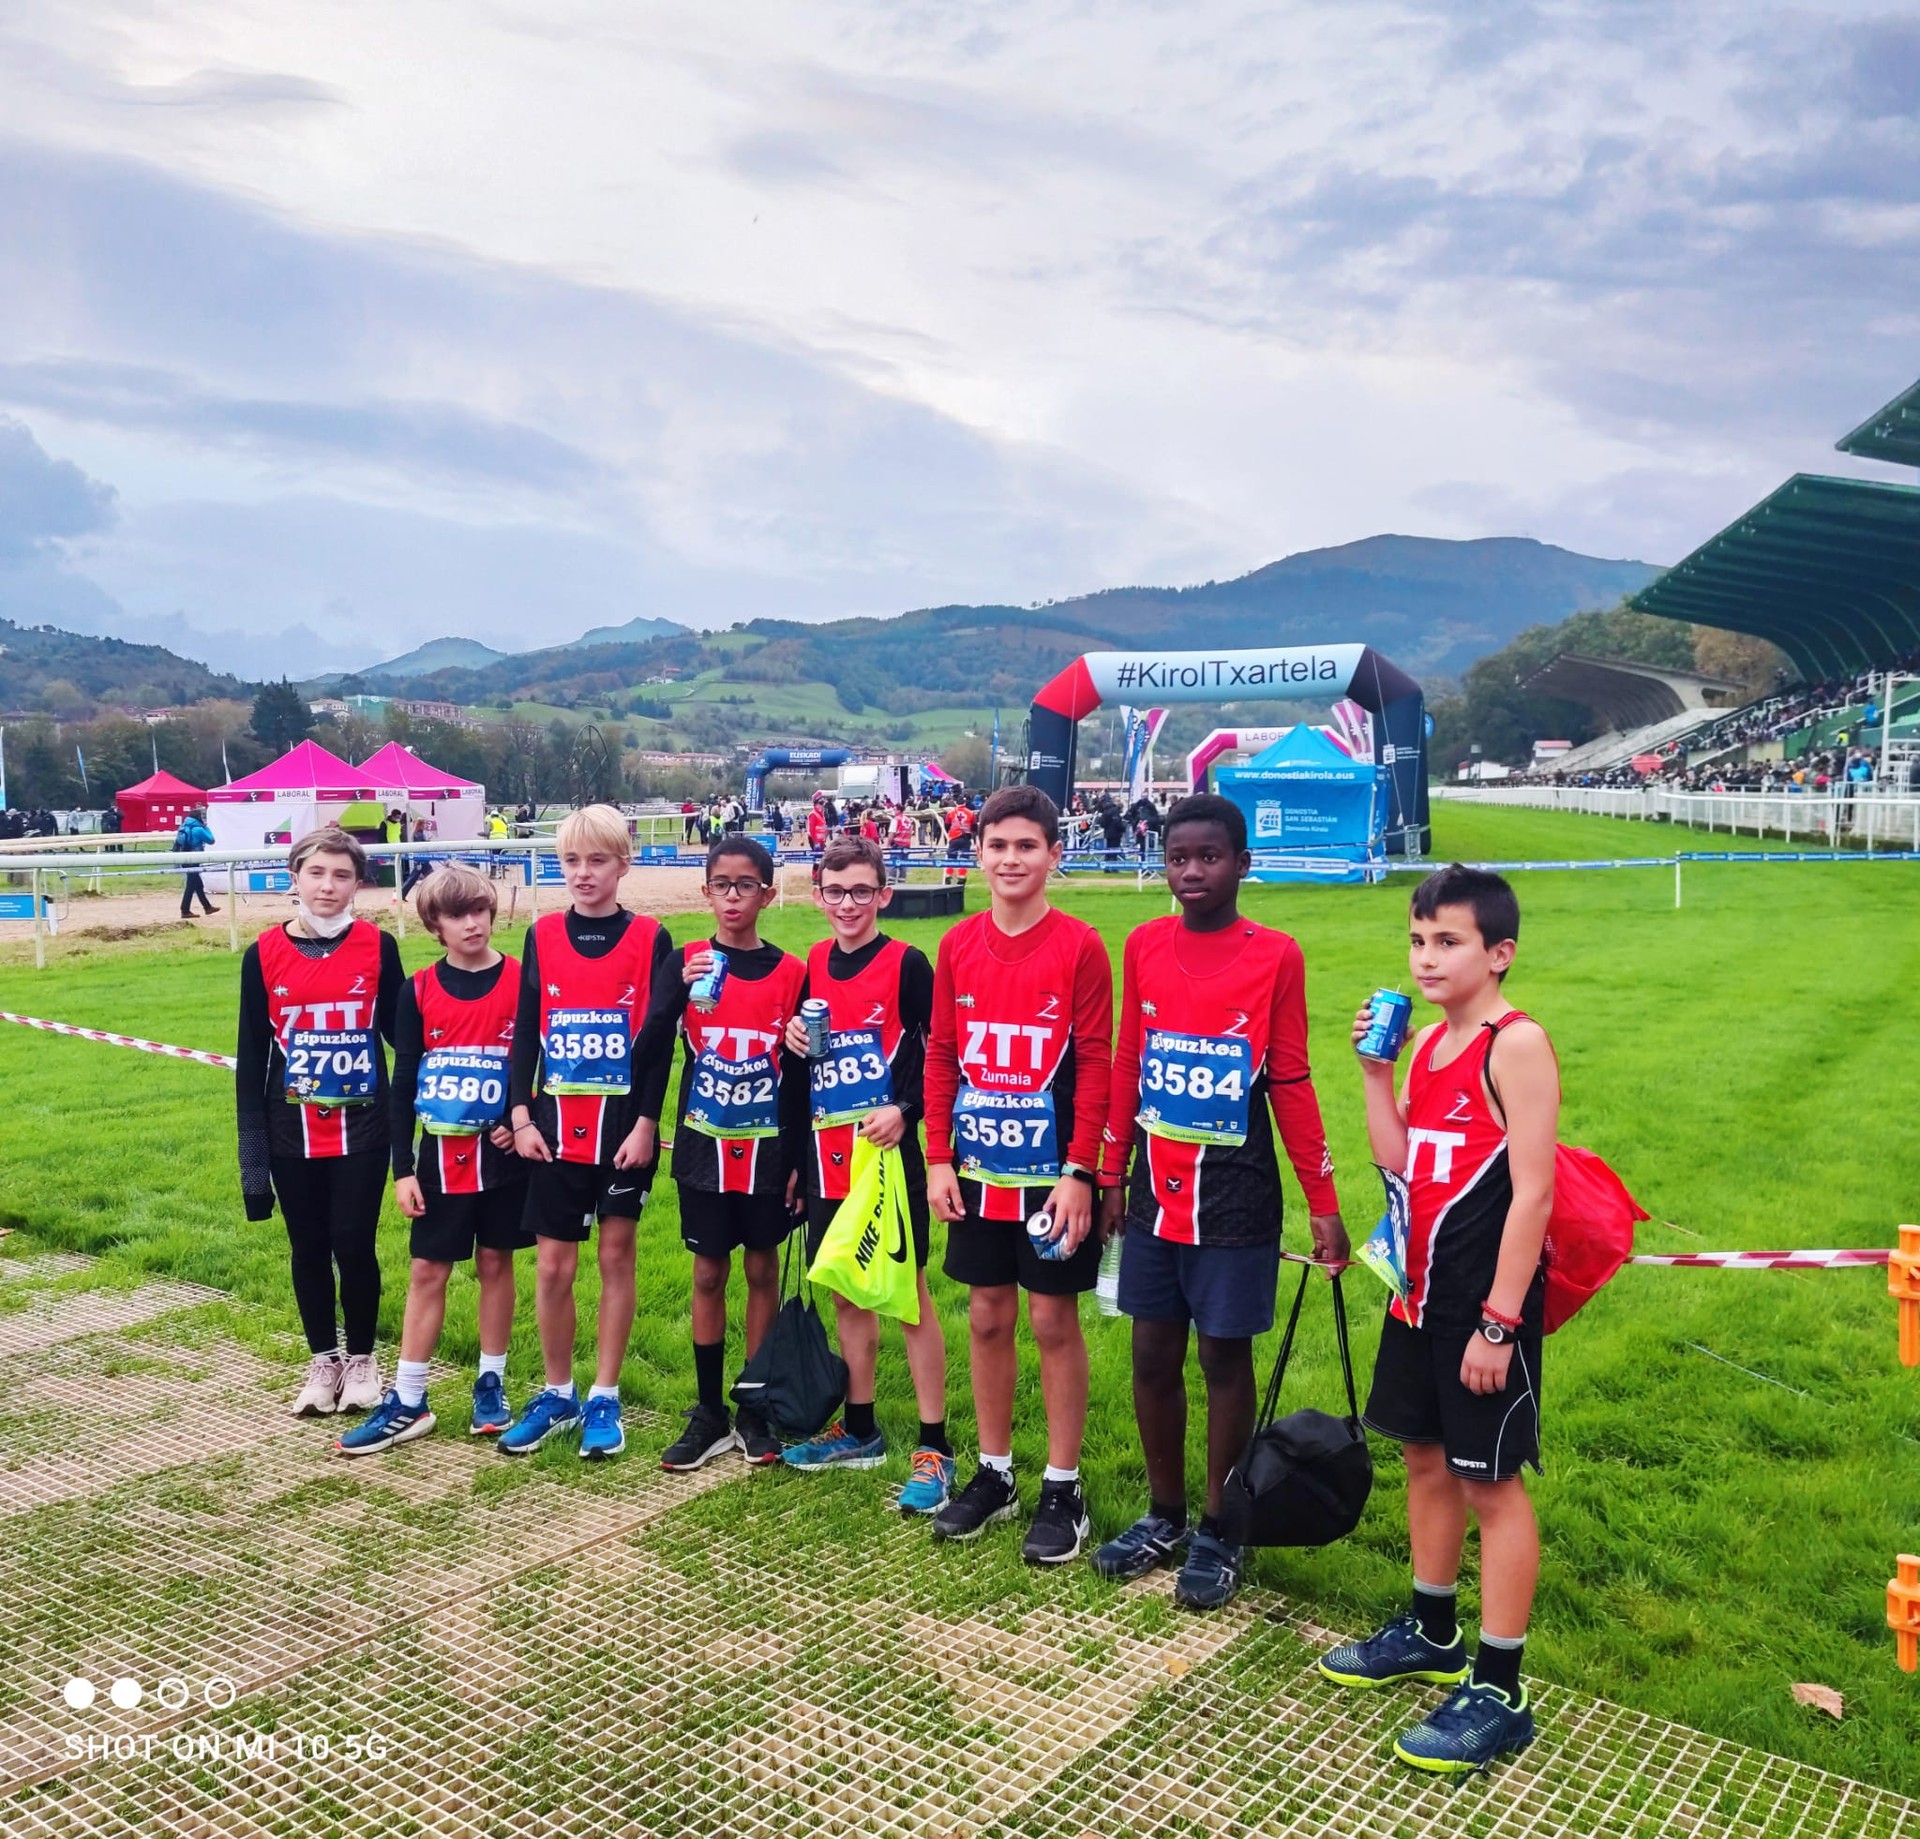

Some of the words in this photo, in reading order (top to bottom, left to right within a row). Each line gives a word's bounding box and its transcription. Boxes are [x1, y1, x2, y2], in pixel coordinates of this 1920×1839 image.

[1116, 655, 1338, 688] #KirolTxartela
[1234, 770, 1355, 781] www.donostiakirola.eus
[277, 790, 310, 799] LABORAL
[377, 790, 404, 798] LABORAL
[551, 1010, 623, 1027] gipuzkoa
[294, 1030, 367, 1047] gipuzkoa
[549, 1033, 626, 1060] 3588
[964, 1020, 1053, 1070] ZTT
[1151, 1031, 1243, 1057] gipuzkoa
[289, 1049, 372, 1075] 2704
[427, 1053, 503, 1070] gipuzkoa
[702, 1053, 770, 1076] gipuzkoa
[813, 1053, 885, 1091] 3583
[422, 1075, 503, 1104] 3580
[696, 1072, 774, 1107] 3582
[981, 1067, 1032, 1086] Zumaia
[1146, 1058, 1244, 1101] 3584
[962, 1090, 1046, 1110] gipuzkoa
[959, 1113, 1050, 1148] 3587
[1404, 1126, 1467, 1184] TT
[854, 1219, 881, 1272] NIKE
